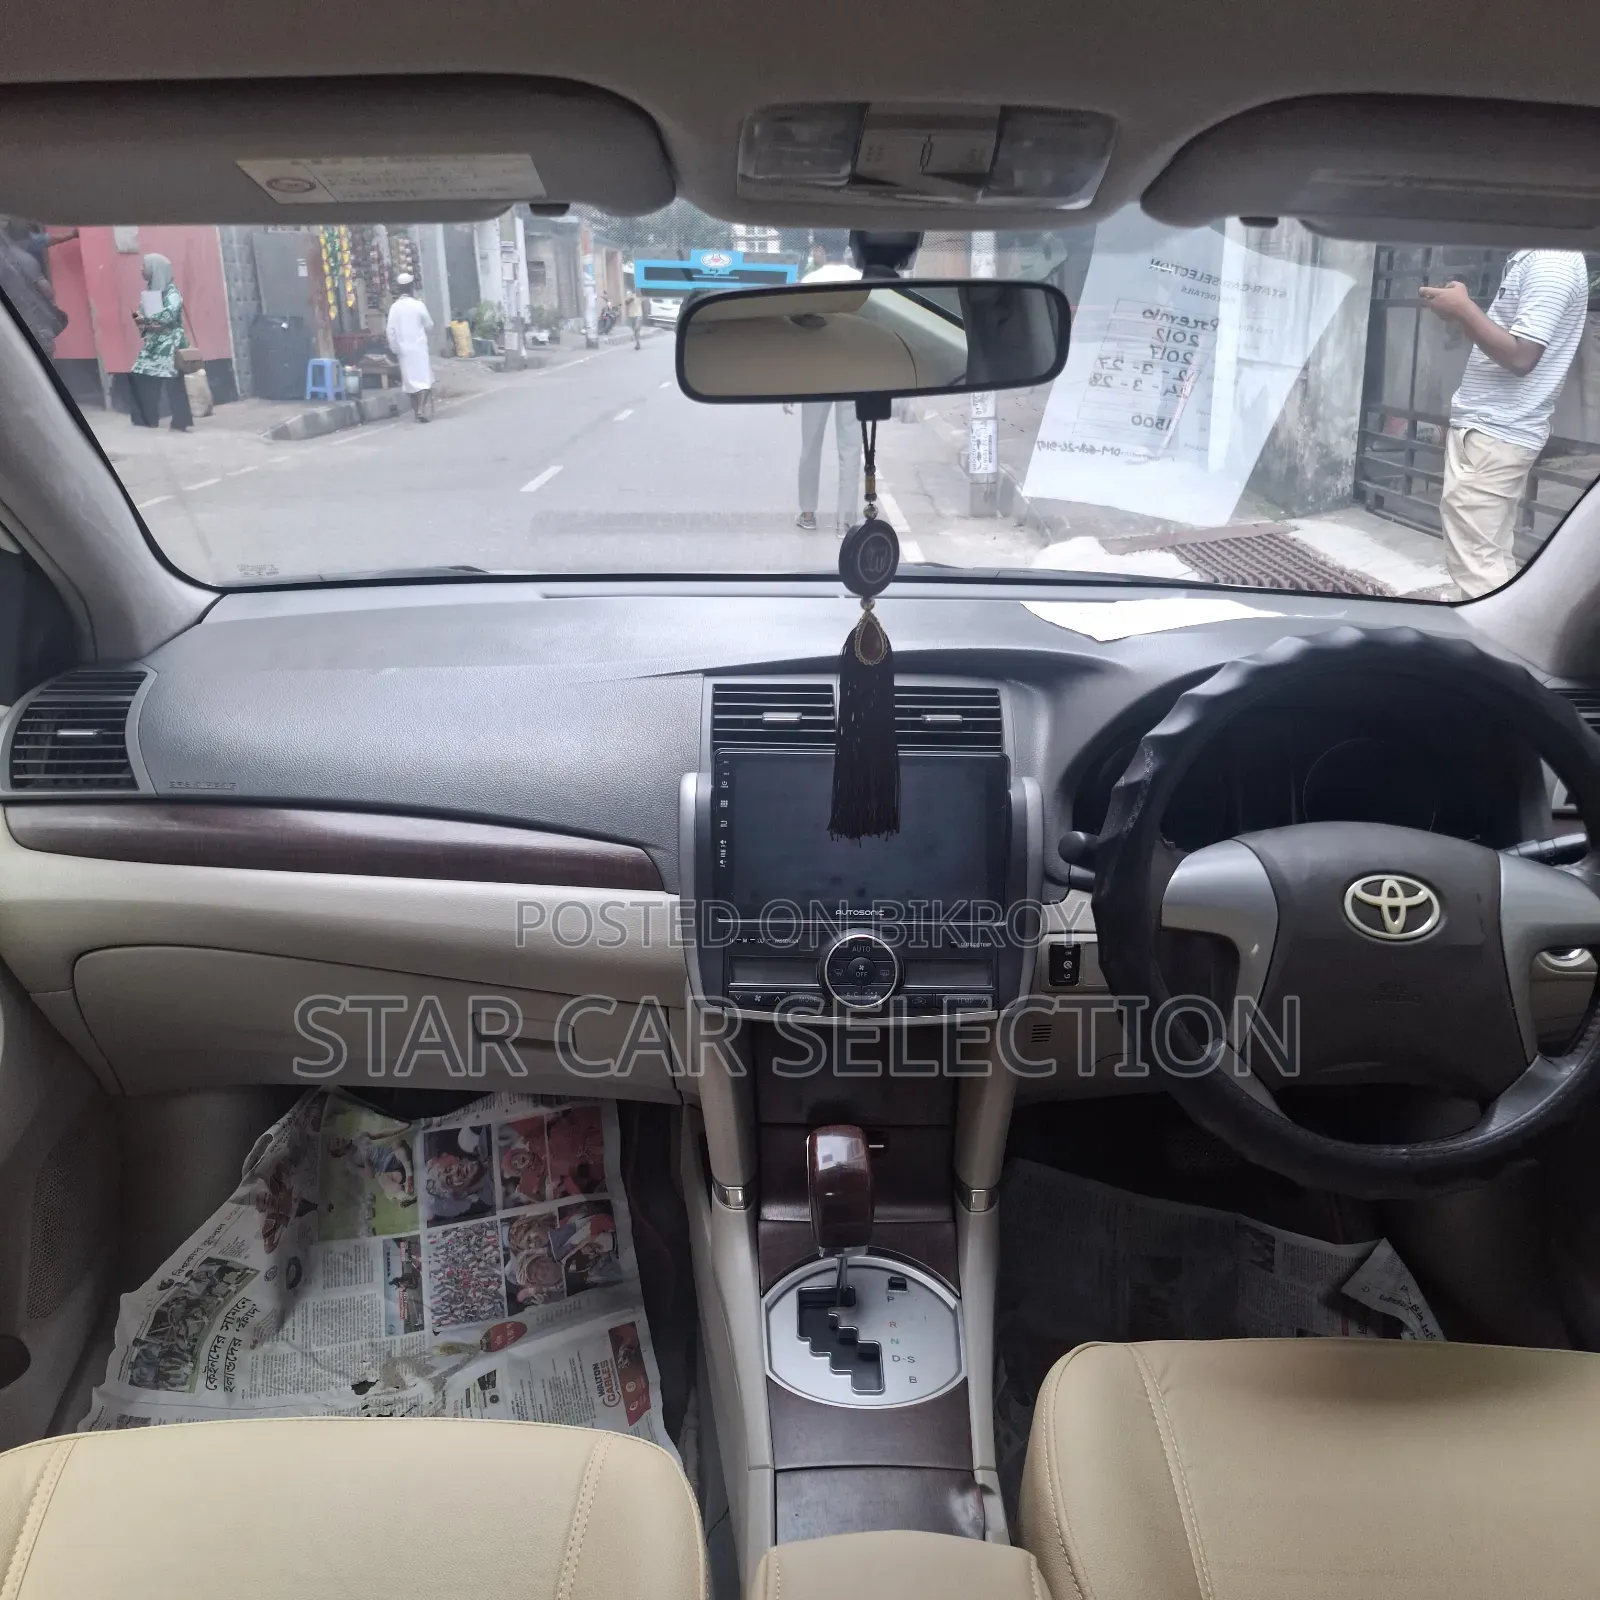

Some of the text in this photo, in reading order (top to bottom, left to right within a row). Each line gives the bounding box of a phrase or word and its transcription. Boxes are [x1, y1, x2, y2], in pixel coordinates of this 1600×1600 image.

[887, 1295, 895, 1303] P
[202, 1297, 252, 1391] কেইনদের সামনে
[890, 1337, 899, 1345] N
[223, 1336, 243, 1393] হলান্ডদের
[592, 1362, 606, 1397] WALTON
[600, 1359, 616, 1402] CABLES
[909, 1375, 918, 1384] B
